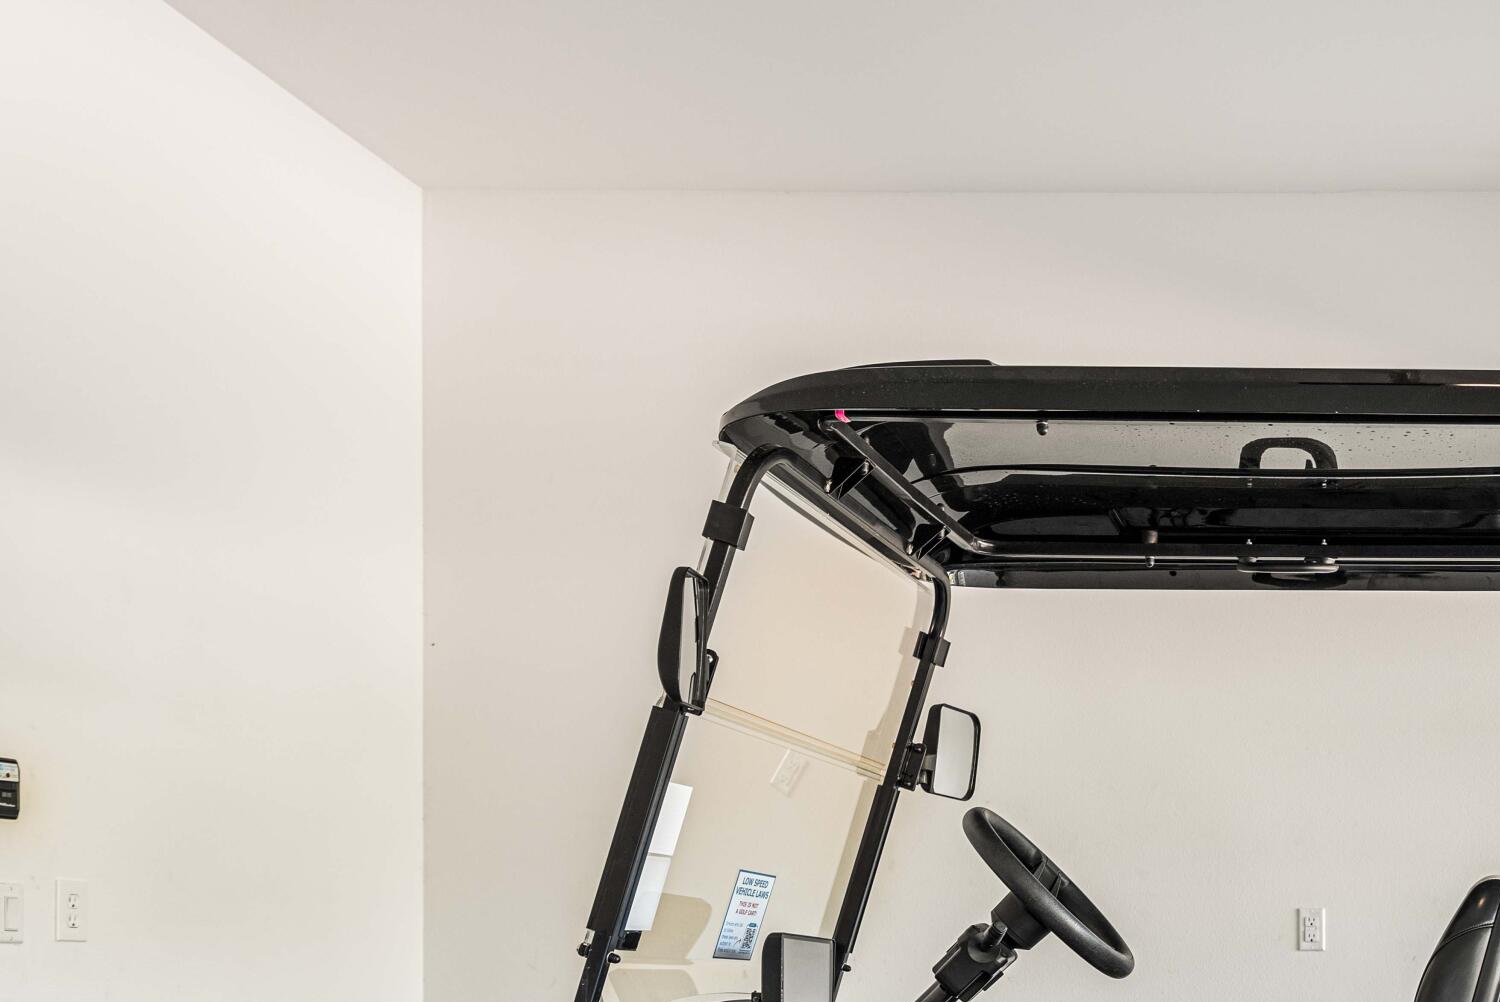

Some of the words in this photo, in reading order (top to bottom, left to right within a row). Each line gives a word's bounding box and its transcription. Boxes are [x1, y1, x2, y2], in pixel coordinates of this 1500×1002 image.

[743, 877, 753, 886] LOW
[754, 879, 768, 889] SPEED
[736, 886, 756, 897] VEHICLE
[756, 890, 769, 900] LAWS
